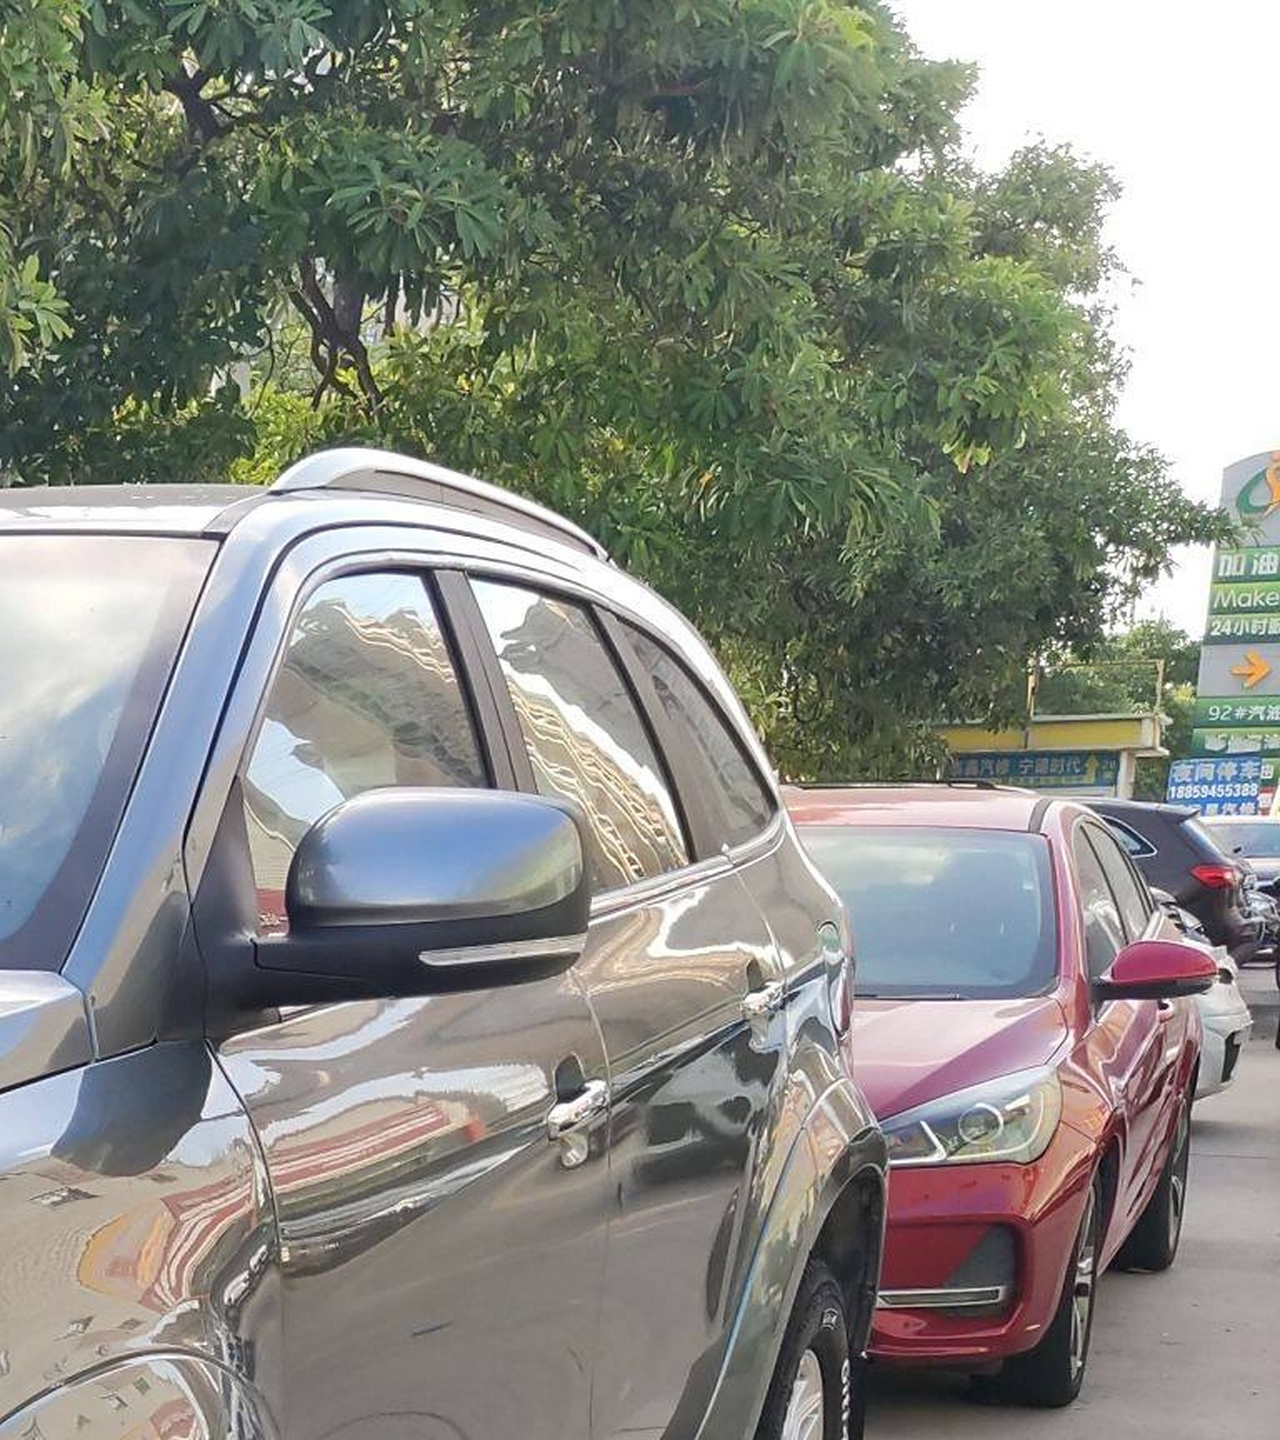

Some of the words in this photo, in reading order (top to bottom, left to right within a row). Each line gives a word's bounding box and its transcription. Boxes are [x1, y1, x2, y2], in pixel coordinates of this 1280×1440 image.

[1218, 552, 1279, 577] 加油
[1172, 761, 1261, 782] 夜间停车
